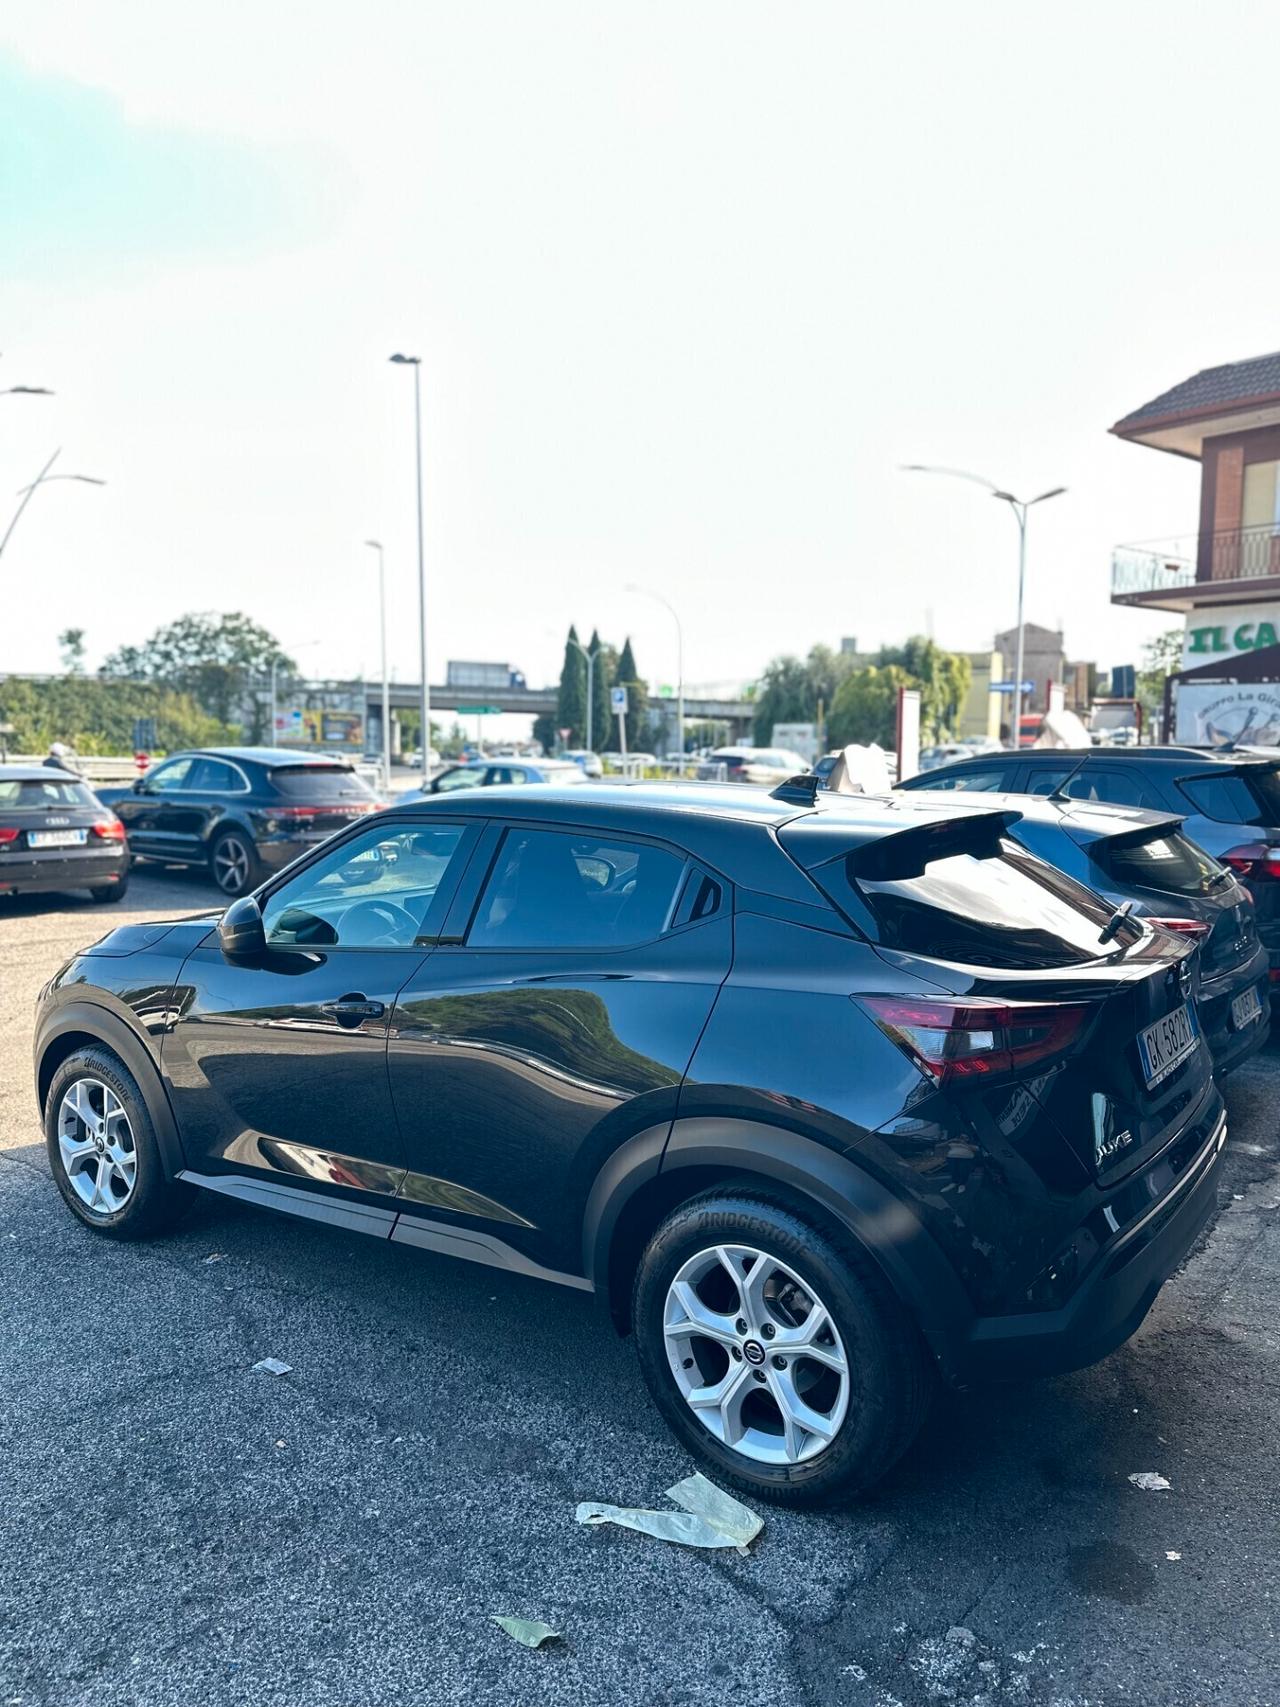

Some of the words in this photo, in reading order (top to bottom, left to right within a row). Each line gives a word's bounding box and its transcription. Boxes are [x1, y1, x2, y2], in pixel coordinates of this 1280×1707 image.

[1188, 626, 1229, 653] IL
[1237, 691, 1254, 701] La
[1146, 1029, 1164, 1069] GK
[84, 1057, 131, 1103] BRIDGESTONE
[1096, 1129, 1133, 1166] JUKE
[698, 1212, 806, 1255] BRIDGESTONE
